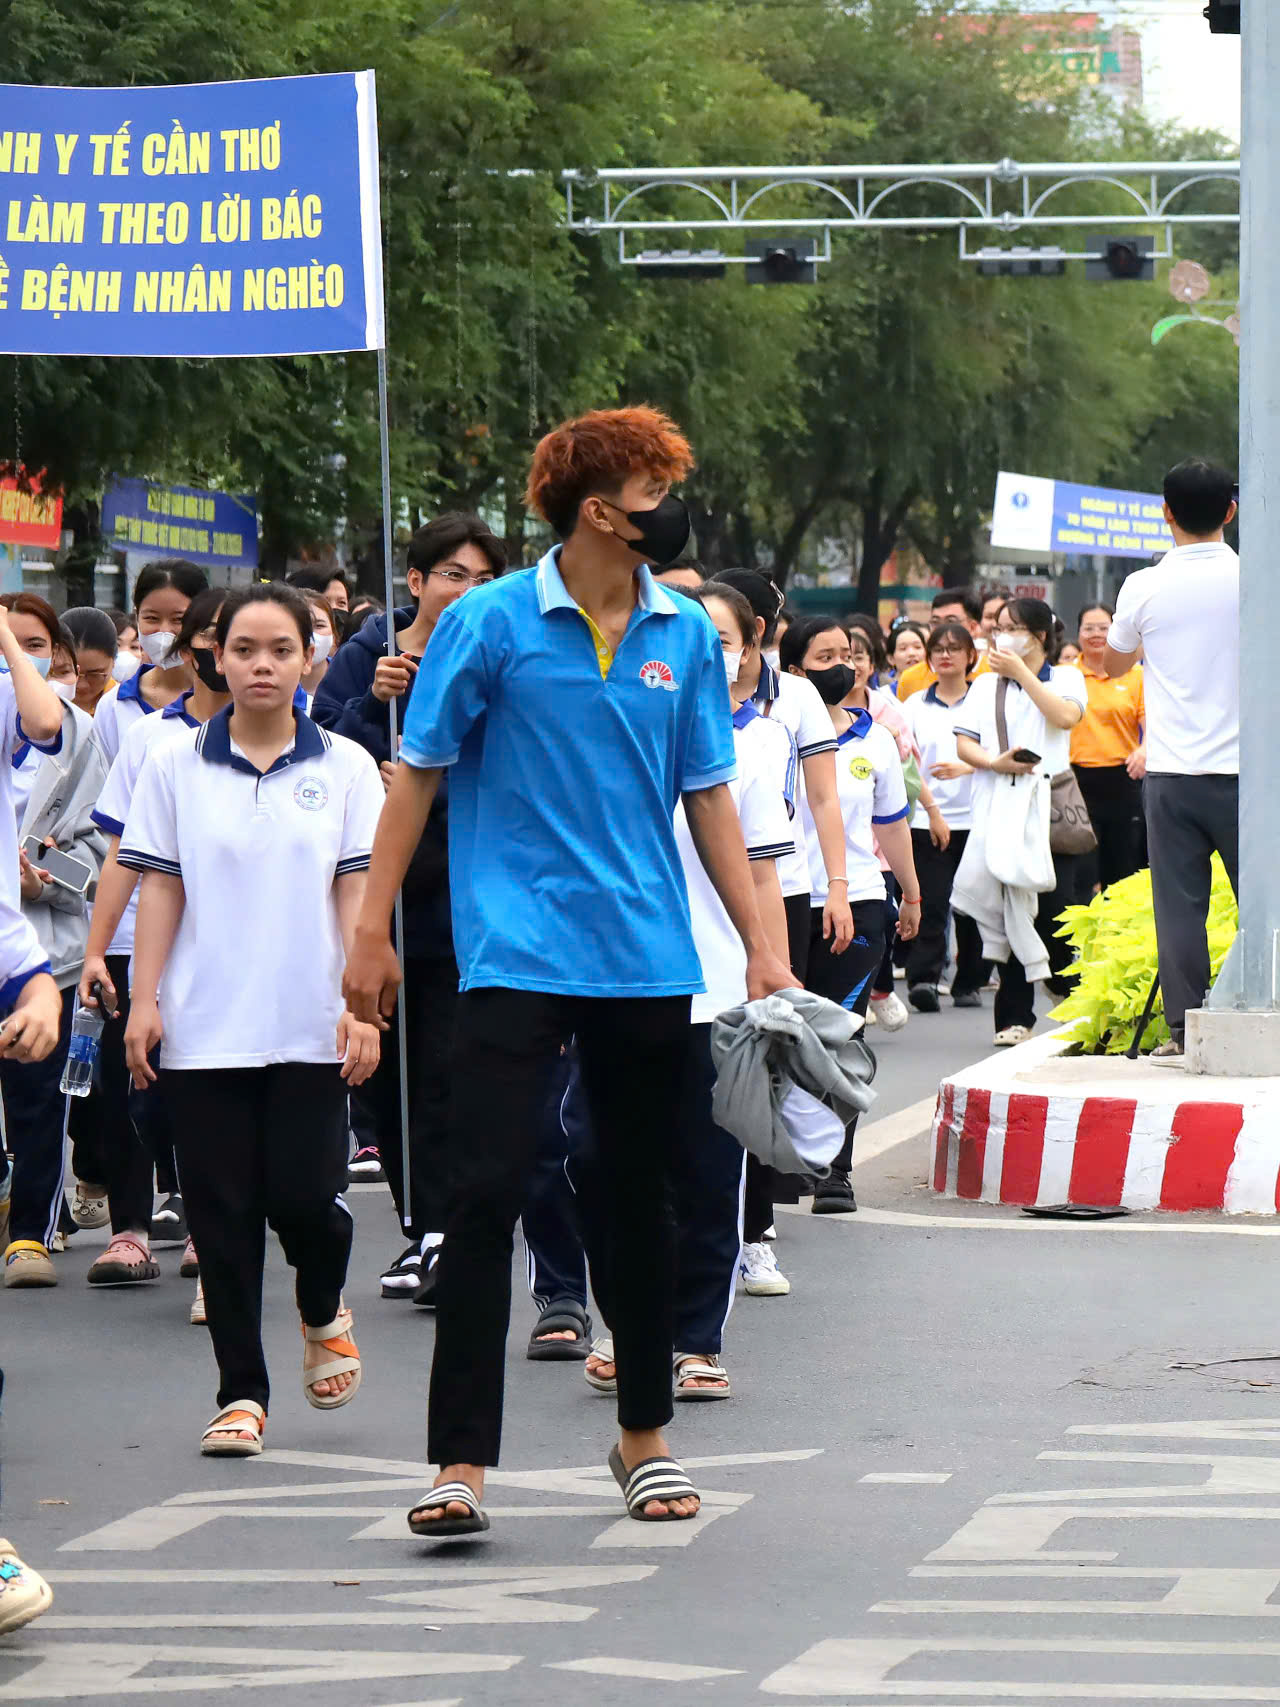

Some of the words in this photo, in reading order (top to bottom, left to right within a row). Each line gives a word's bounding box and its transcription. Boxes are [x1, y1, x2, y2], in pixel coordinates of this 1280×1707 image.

[54, 134, 79, 175] Y
[89, 120, 132, 176] TẾ
[142, 119, 210, 176] CẦN
[220, 120, 281, 172] THƠ
[6, 194, 86, 244] LÀM
[98, 202, 189, 244] THEO
[200, 192, 251, 243] LỜI
[261, 189, 322, 241] BÁC
[21, 262, 122, 320] BỆNH
[133, 263, 231, 313] NHÂN
[243, 258, 344, 311] NGHÈO
[0, 1564, 746, 1707] MÁ
